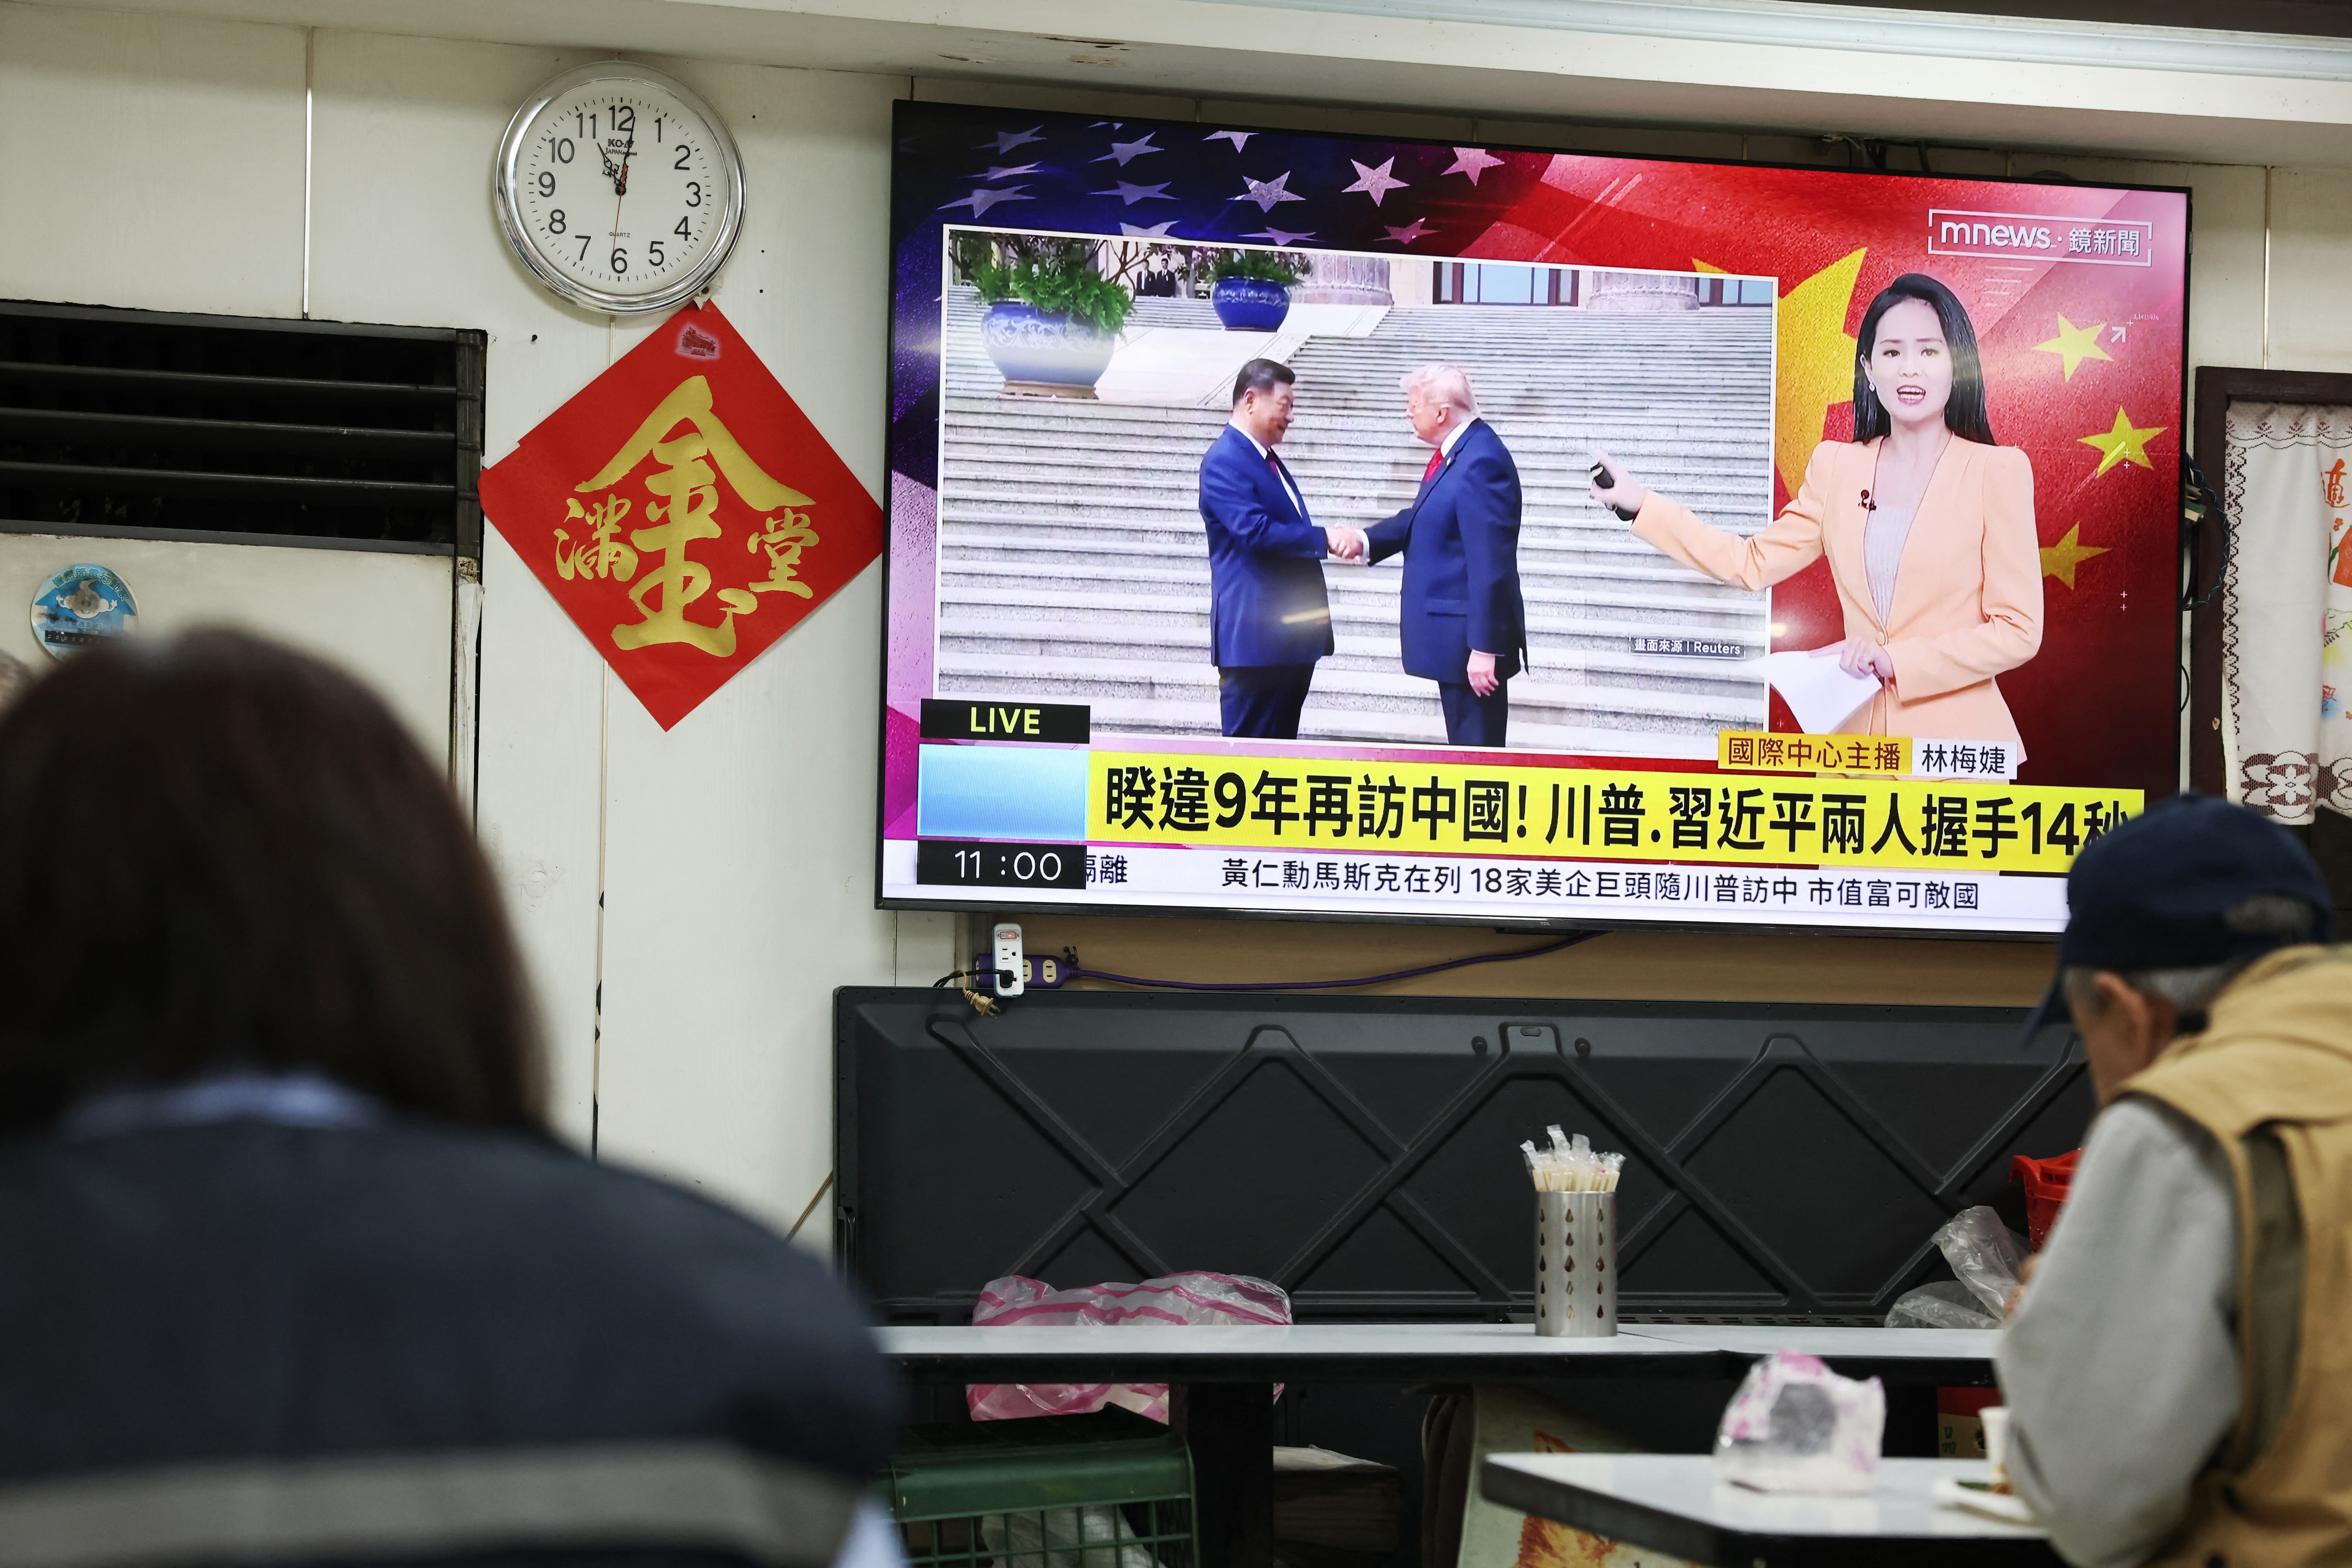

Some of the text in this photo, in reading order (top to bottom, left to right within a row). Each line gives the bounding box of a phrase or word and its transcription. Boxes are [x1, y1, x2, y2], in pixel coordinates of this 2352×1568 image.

[576, 113, 596, 139] 11
[608, 105, 634, 132] 12
[655, 118, 661, 142] 1
[548, 137, 574, 163] 10
[674, 145, 690, 170] 2
[538, 171, 555, 197] 9
[686, 182, 701, 207] 3
[549, 209, 566, 234] 8
[674, 216, 691, 241] 4
[575, 235, 591, 260] 7
[1941, 221, 2140, 257] mnews 鏡新聞
[611, 248, 627, 273] 6
[648, 241, 664, 266] 5
[1634, 638, 1741, 655] 畫面來源 Reuters
[971, 707, 1040, 735] LIVE
[1729, 737, 2006, 774] 國際中心主播 林梅婕
